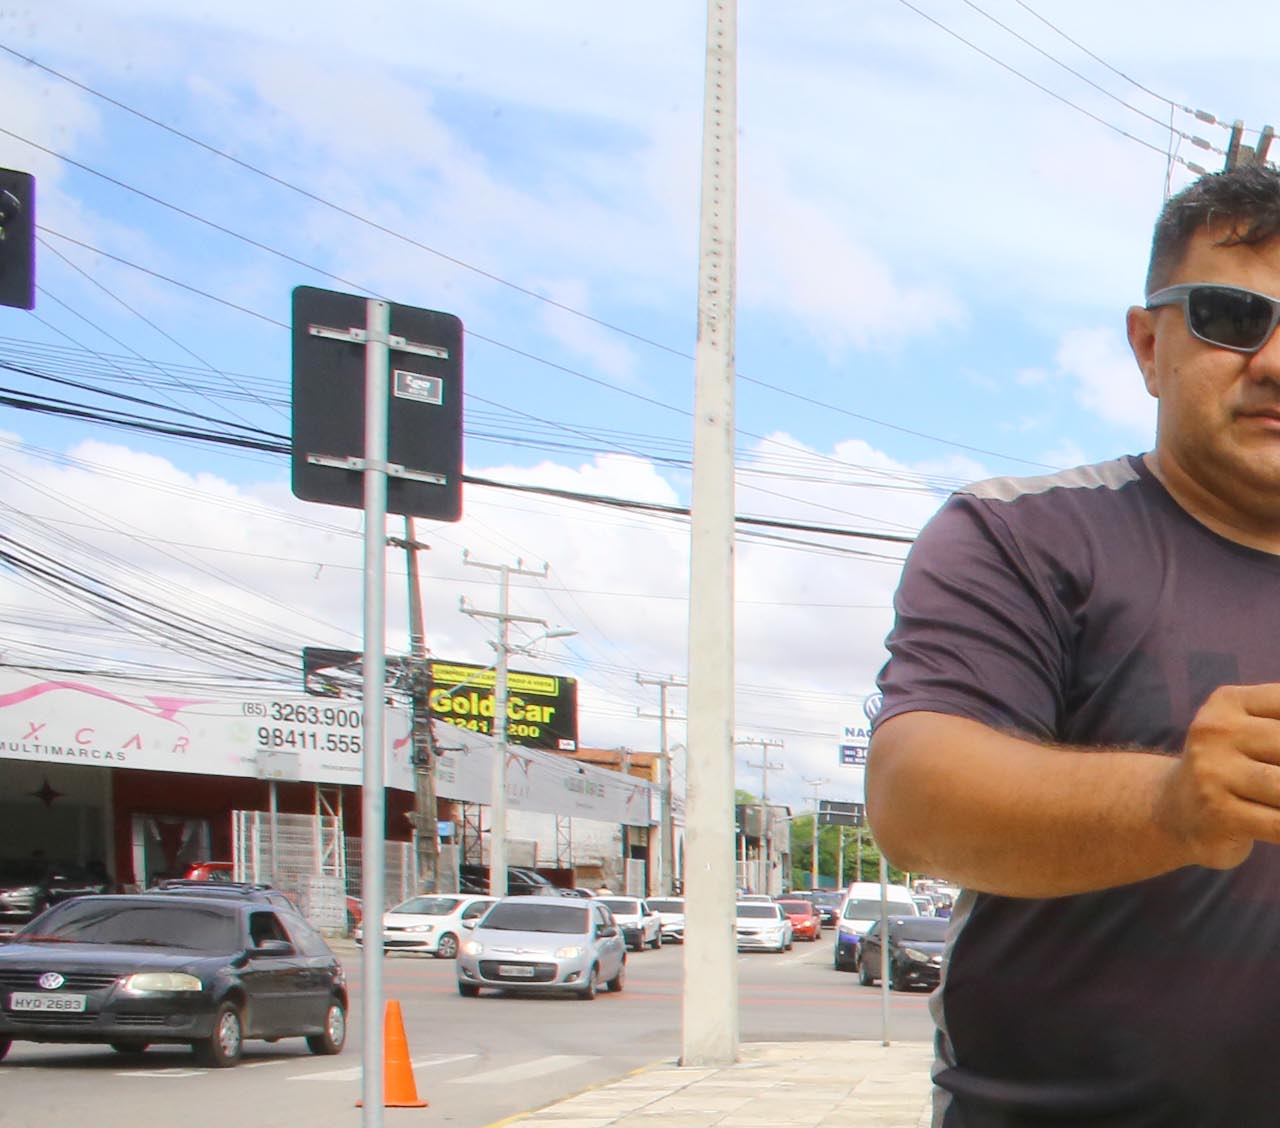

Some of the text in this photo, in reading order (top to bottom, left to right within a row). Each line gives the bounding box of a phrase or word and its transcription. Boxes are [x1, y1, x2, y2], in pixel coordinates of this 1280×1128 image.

[243, 702, 364, 729] (85) 3263.900
[430, 687, 556, 723] Gold Car
[258, 726, 363, 754] 98411.555
